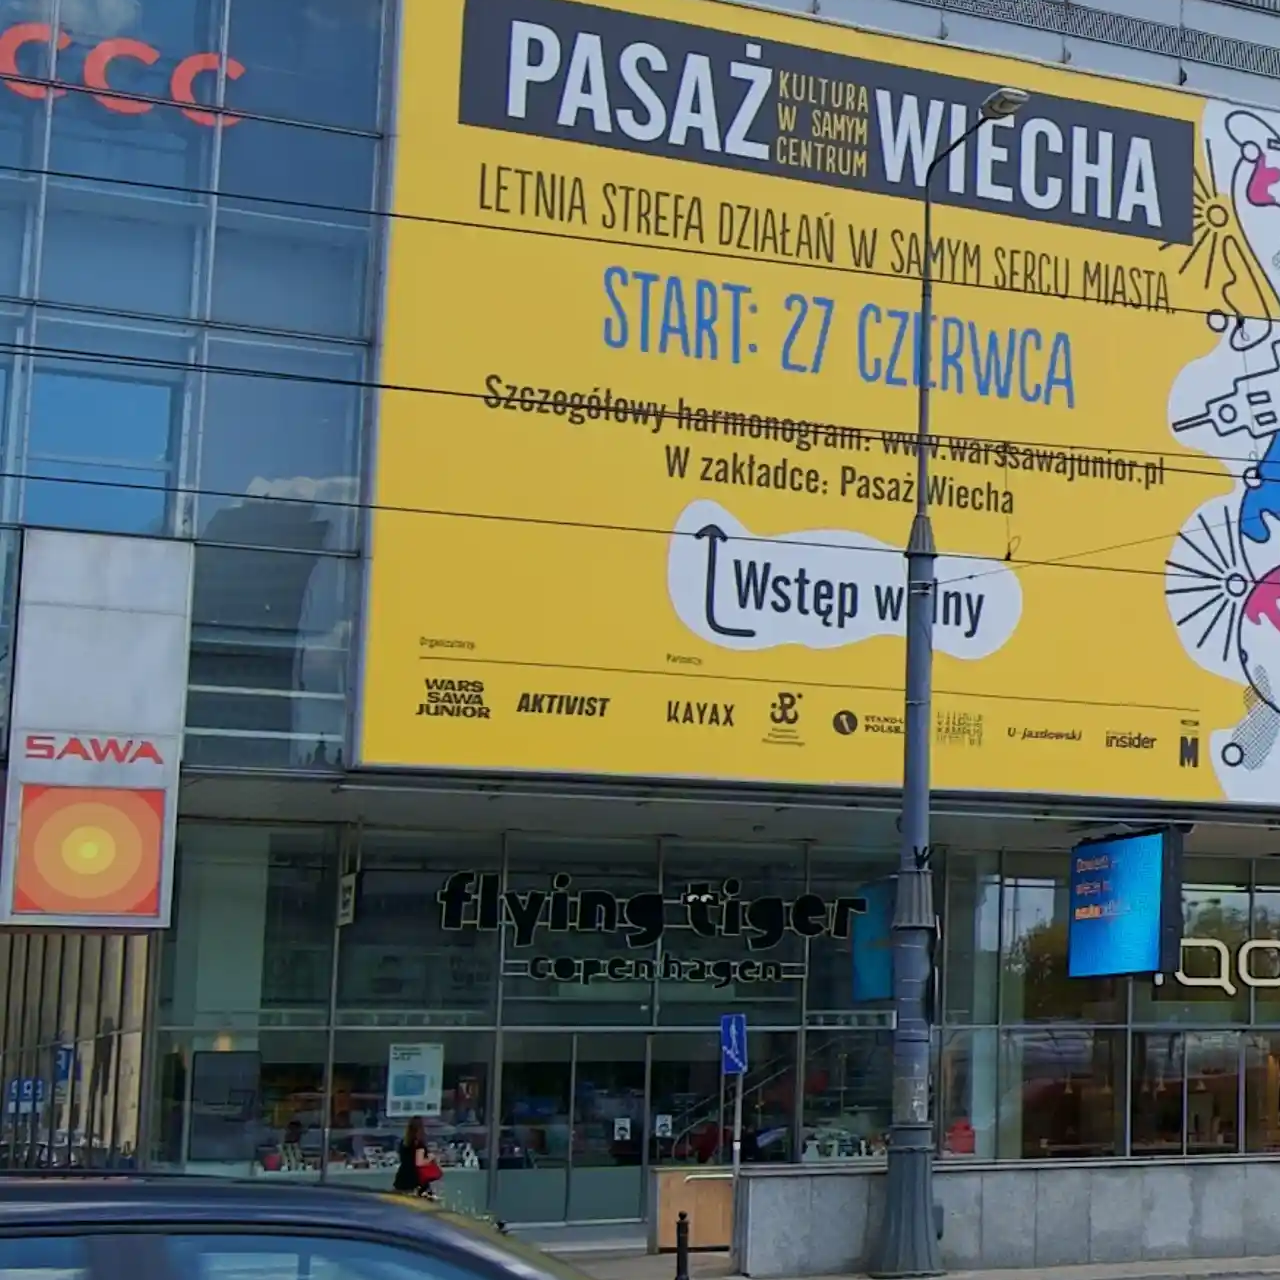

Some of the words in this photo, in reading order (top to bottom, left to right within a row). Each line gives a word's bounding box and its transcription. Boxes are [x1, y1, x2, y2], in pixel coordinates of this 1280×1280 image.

[0, 22, 246, 127] CCC
[778, 70, 869, 113] KULTURA
[507, 20, 773, 160] PASAŻ
[875, 88, 1162, 228] WIECHA
[777, 103, 796, 131] W
[811, 109, 868, 145] SAMYM
[777, 137, 868, 178] CENTRUM
[479, 163, 587, 225] LETNIA
[601, 182, 705, 244] STREFA
[718, 202, 835, 264] DZIAŁAŃ
[848, 223, 878, 270] W
[889, 228, 981, 286] SAMYM
[994, 246, 1070, 300] SERCU
[1083, 260, 1176, 315] MIASTA.
[603, 265, 758, 365] START:
[781, 293, 835, 374] 27
[857, 302, 1076, 410] CZERWCA
[483, 373, 666, 434] Szczegółowy
[678, 397, 871, 452] harmonogram:
[665, 444, 690, 479] W
[700, 452, 829, 496] zakładce:
[840, 465, 914, 504] Pasaż
[926, 475, 1015, 515] Wiecha
[733, 558, 859, 629] Wstęp
[874, 577, 985, 639] wlny
[424, 678, 485, 694] WARS
[427, 692, 484, 706] SAWA
[516, 692, 610, 717] AKTIVIST
[415, 703, 492, 719] JUNIOR
[666, 700, 735, 727] KAYAX
[25, 735, 165, 766] SAWA
[1105, 731, 1157, 750] insider
[436, 869, 665, 948] flying
[680, 877, 869, 951] tiger
[530, 952, 785, 989] copenhagen
